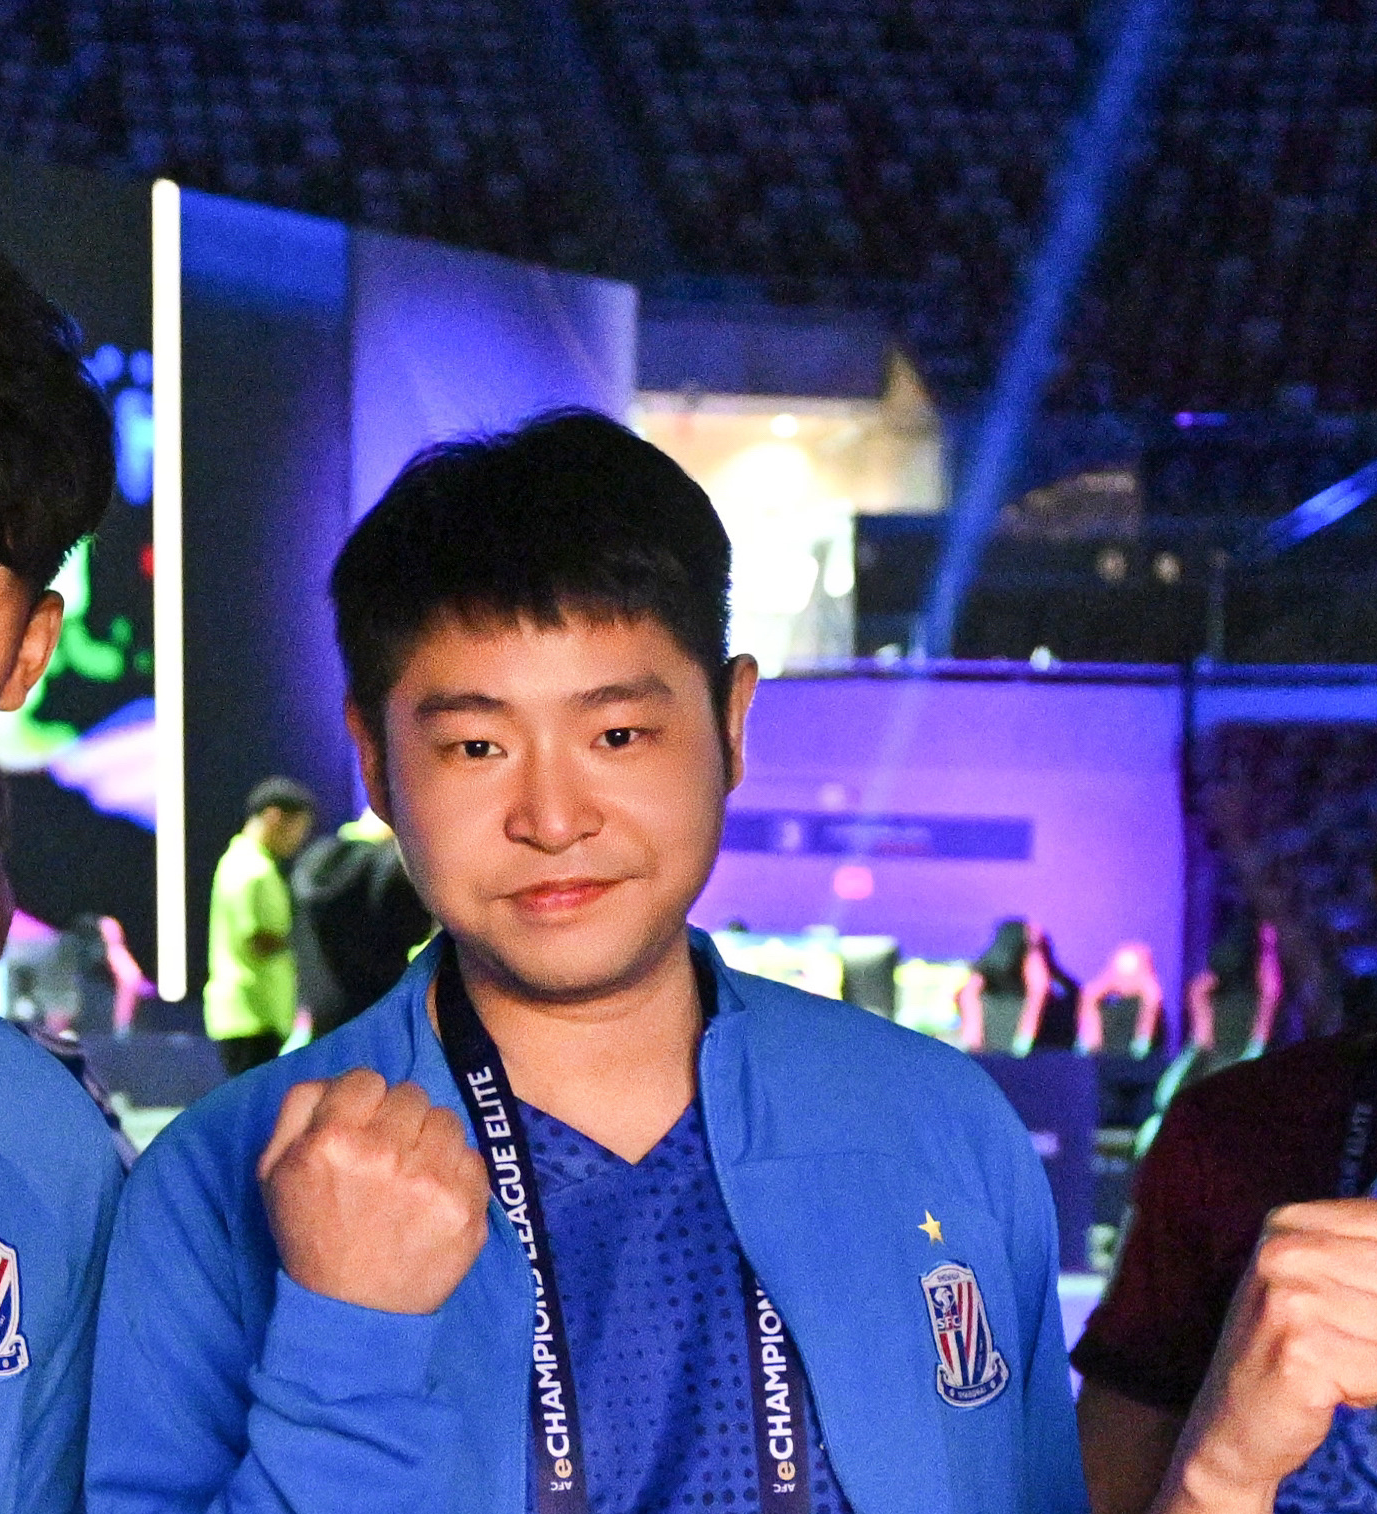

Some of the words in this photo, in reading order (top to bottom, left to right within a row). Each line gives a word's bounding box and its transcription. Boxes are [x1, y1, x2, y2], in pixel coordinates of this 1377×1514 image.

[467, 1066, 512, 1139] ELITE
[754, 1278, 797, 1481] eCHAMPION
[550, 1480, 573, 1491] AFC
[773, 1483, 797, 1493] AFC
